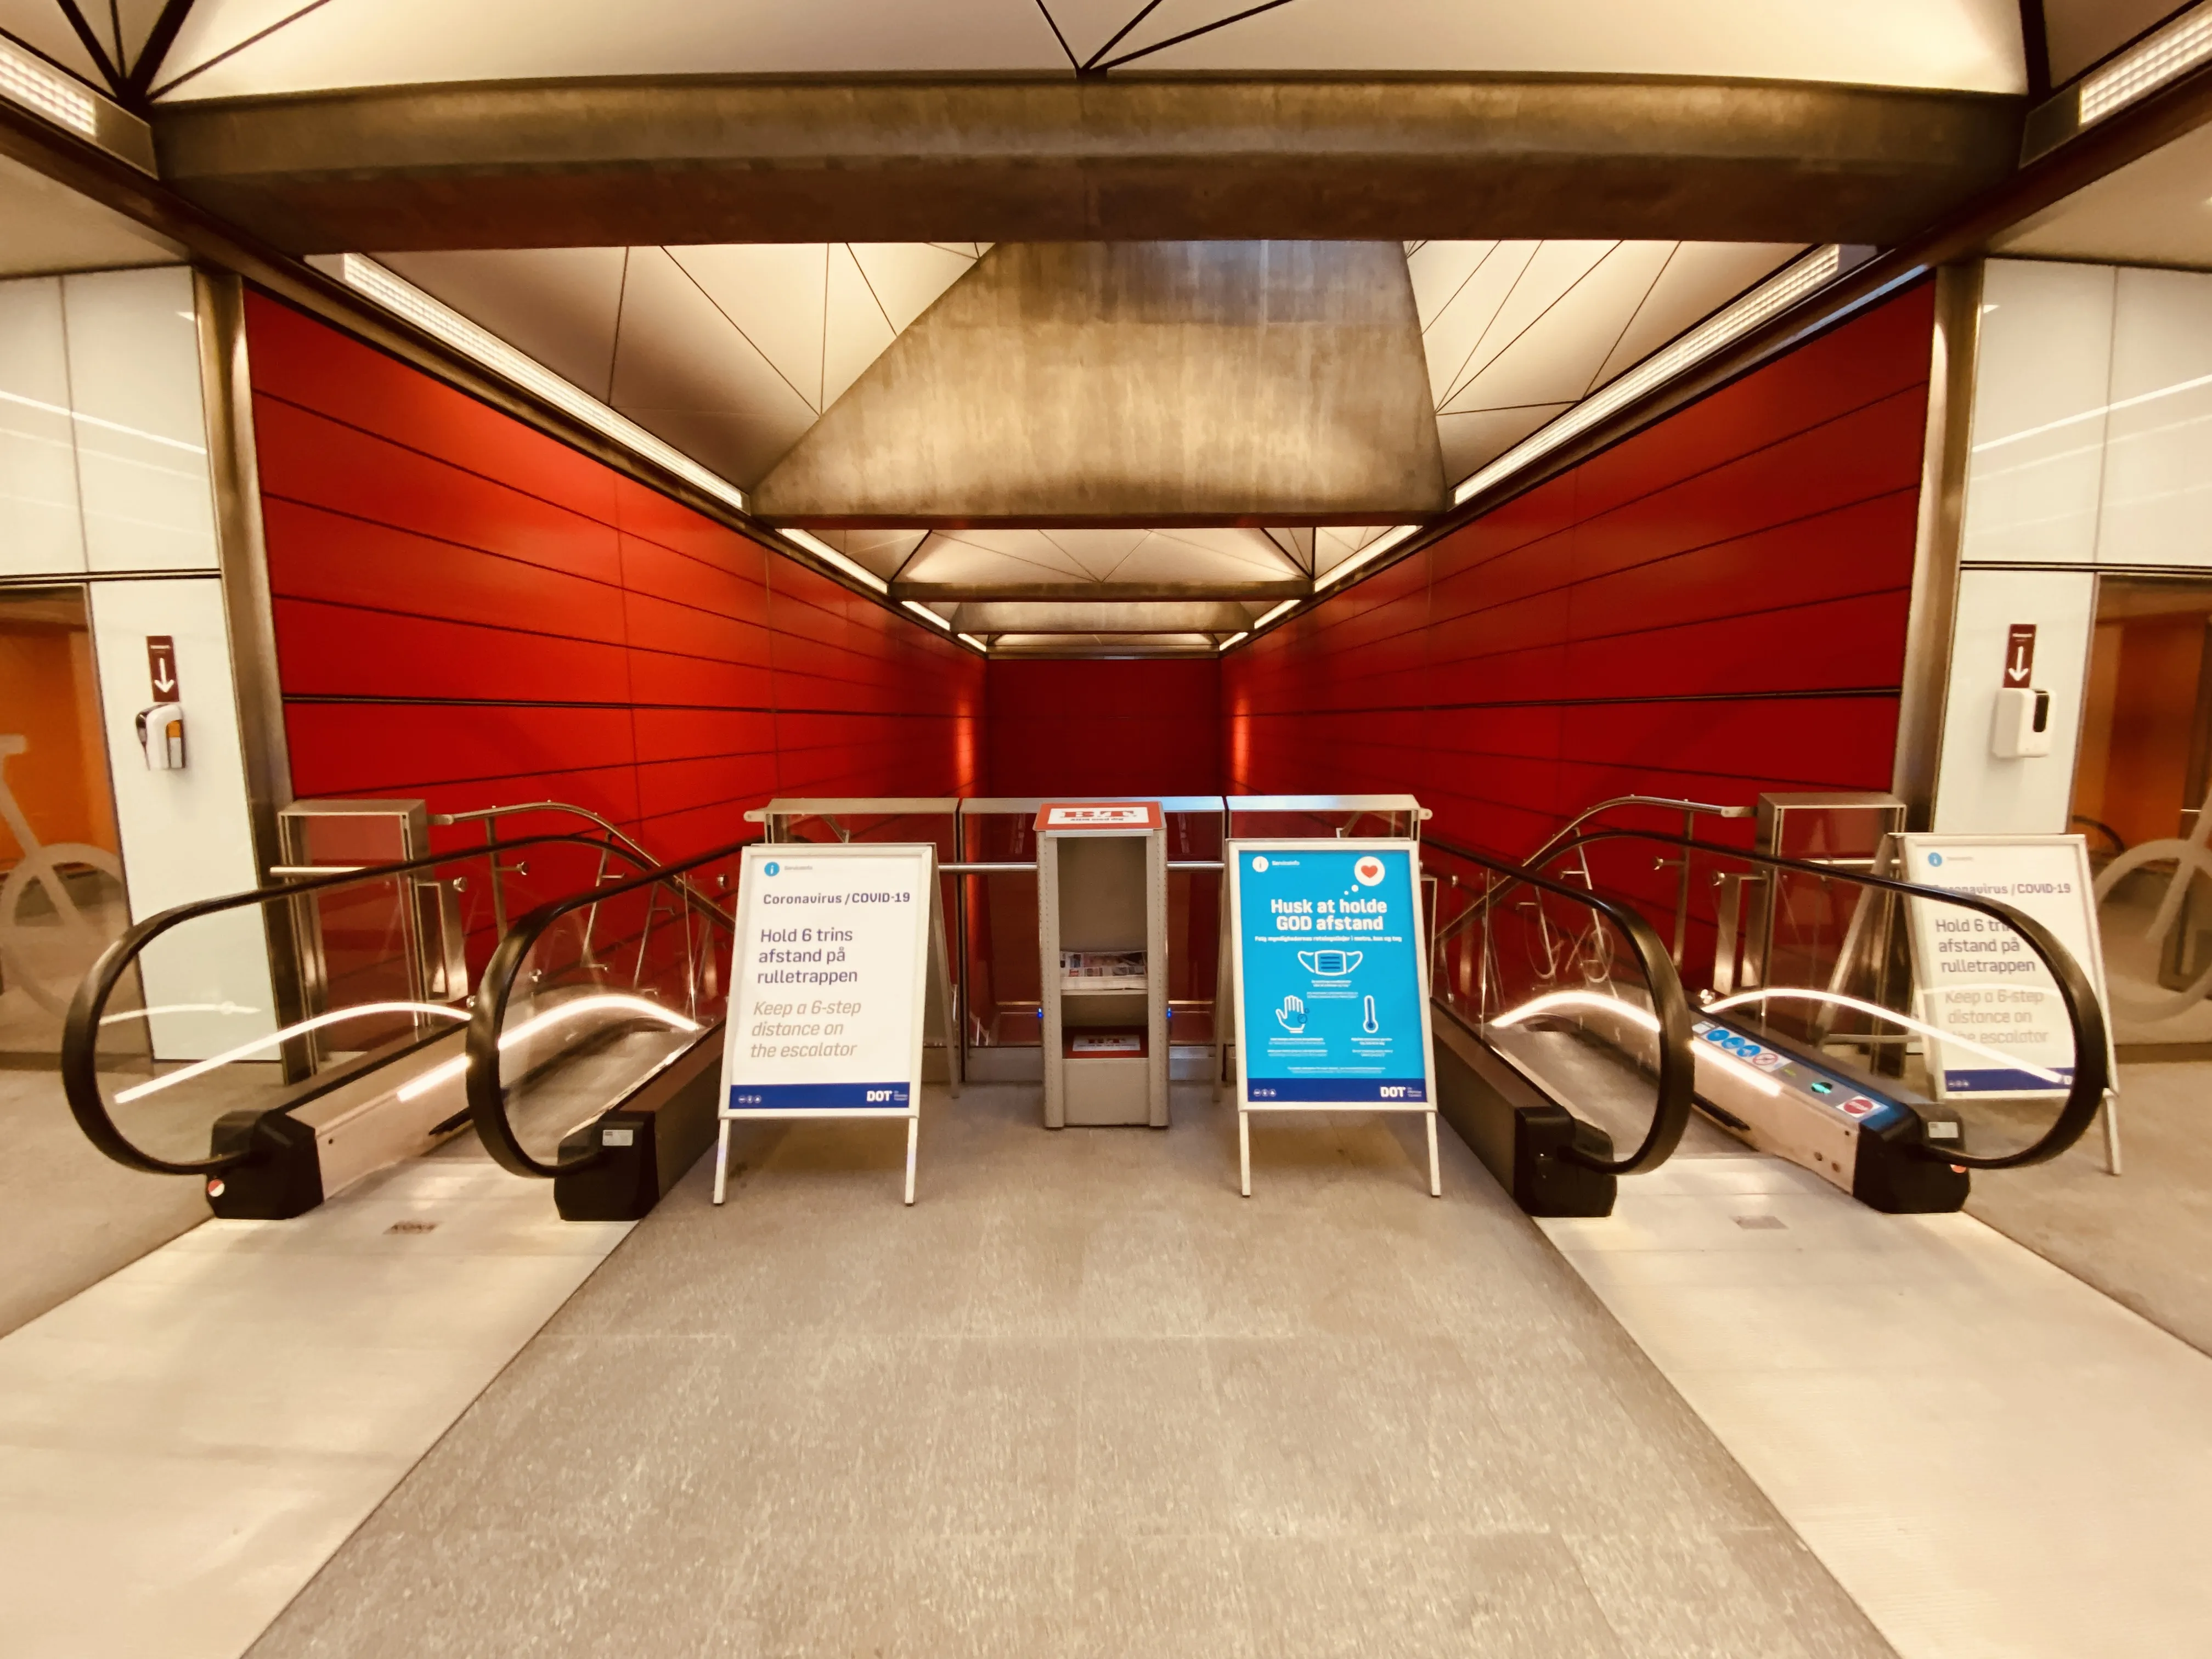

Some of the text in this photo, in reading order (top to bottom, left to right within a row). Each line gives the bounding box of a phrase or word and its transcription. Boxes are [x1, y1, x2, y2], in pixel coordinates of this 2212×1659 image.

[763, 893, 842, 904] Coronavirus
[1271, 898, 1387, 913] Husk at holde
[1276, 915, 1384, 930] GOD afstand
[1936, 918, 1970, 932] Hold
[1974, 918, 1984, 932] 6
[760, 927, 853, 943] Hold 6 trins
[1938, 936, 2020, 955] afstand på
[759, 946, 845, 964] afstand på
[1940, 960, 2036, 975] rulletrappen
[758, 969, 858, 985] rulletrappen
[1945, 990, 1981, 1006] Keep
[1997, 989, 2045, 1005] 6-step
[753, 1000, 862, 1018] Keep a 6-step
[1948, 1009, 2033, 1024] distance on
[752, 1021, 844, 1036] distance on
[1980, 1029, 2049, 1044] escalator
[751, 1042, 857, 1058] the escalator
[867, 1090, 893, 1102] DOT
[1380, 1086, 1406, 1097] DOT
